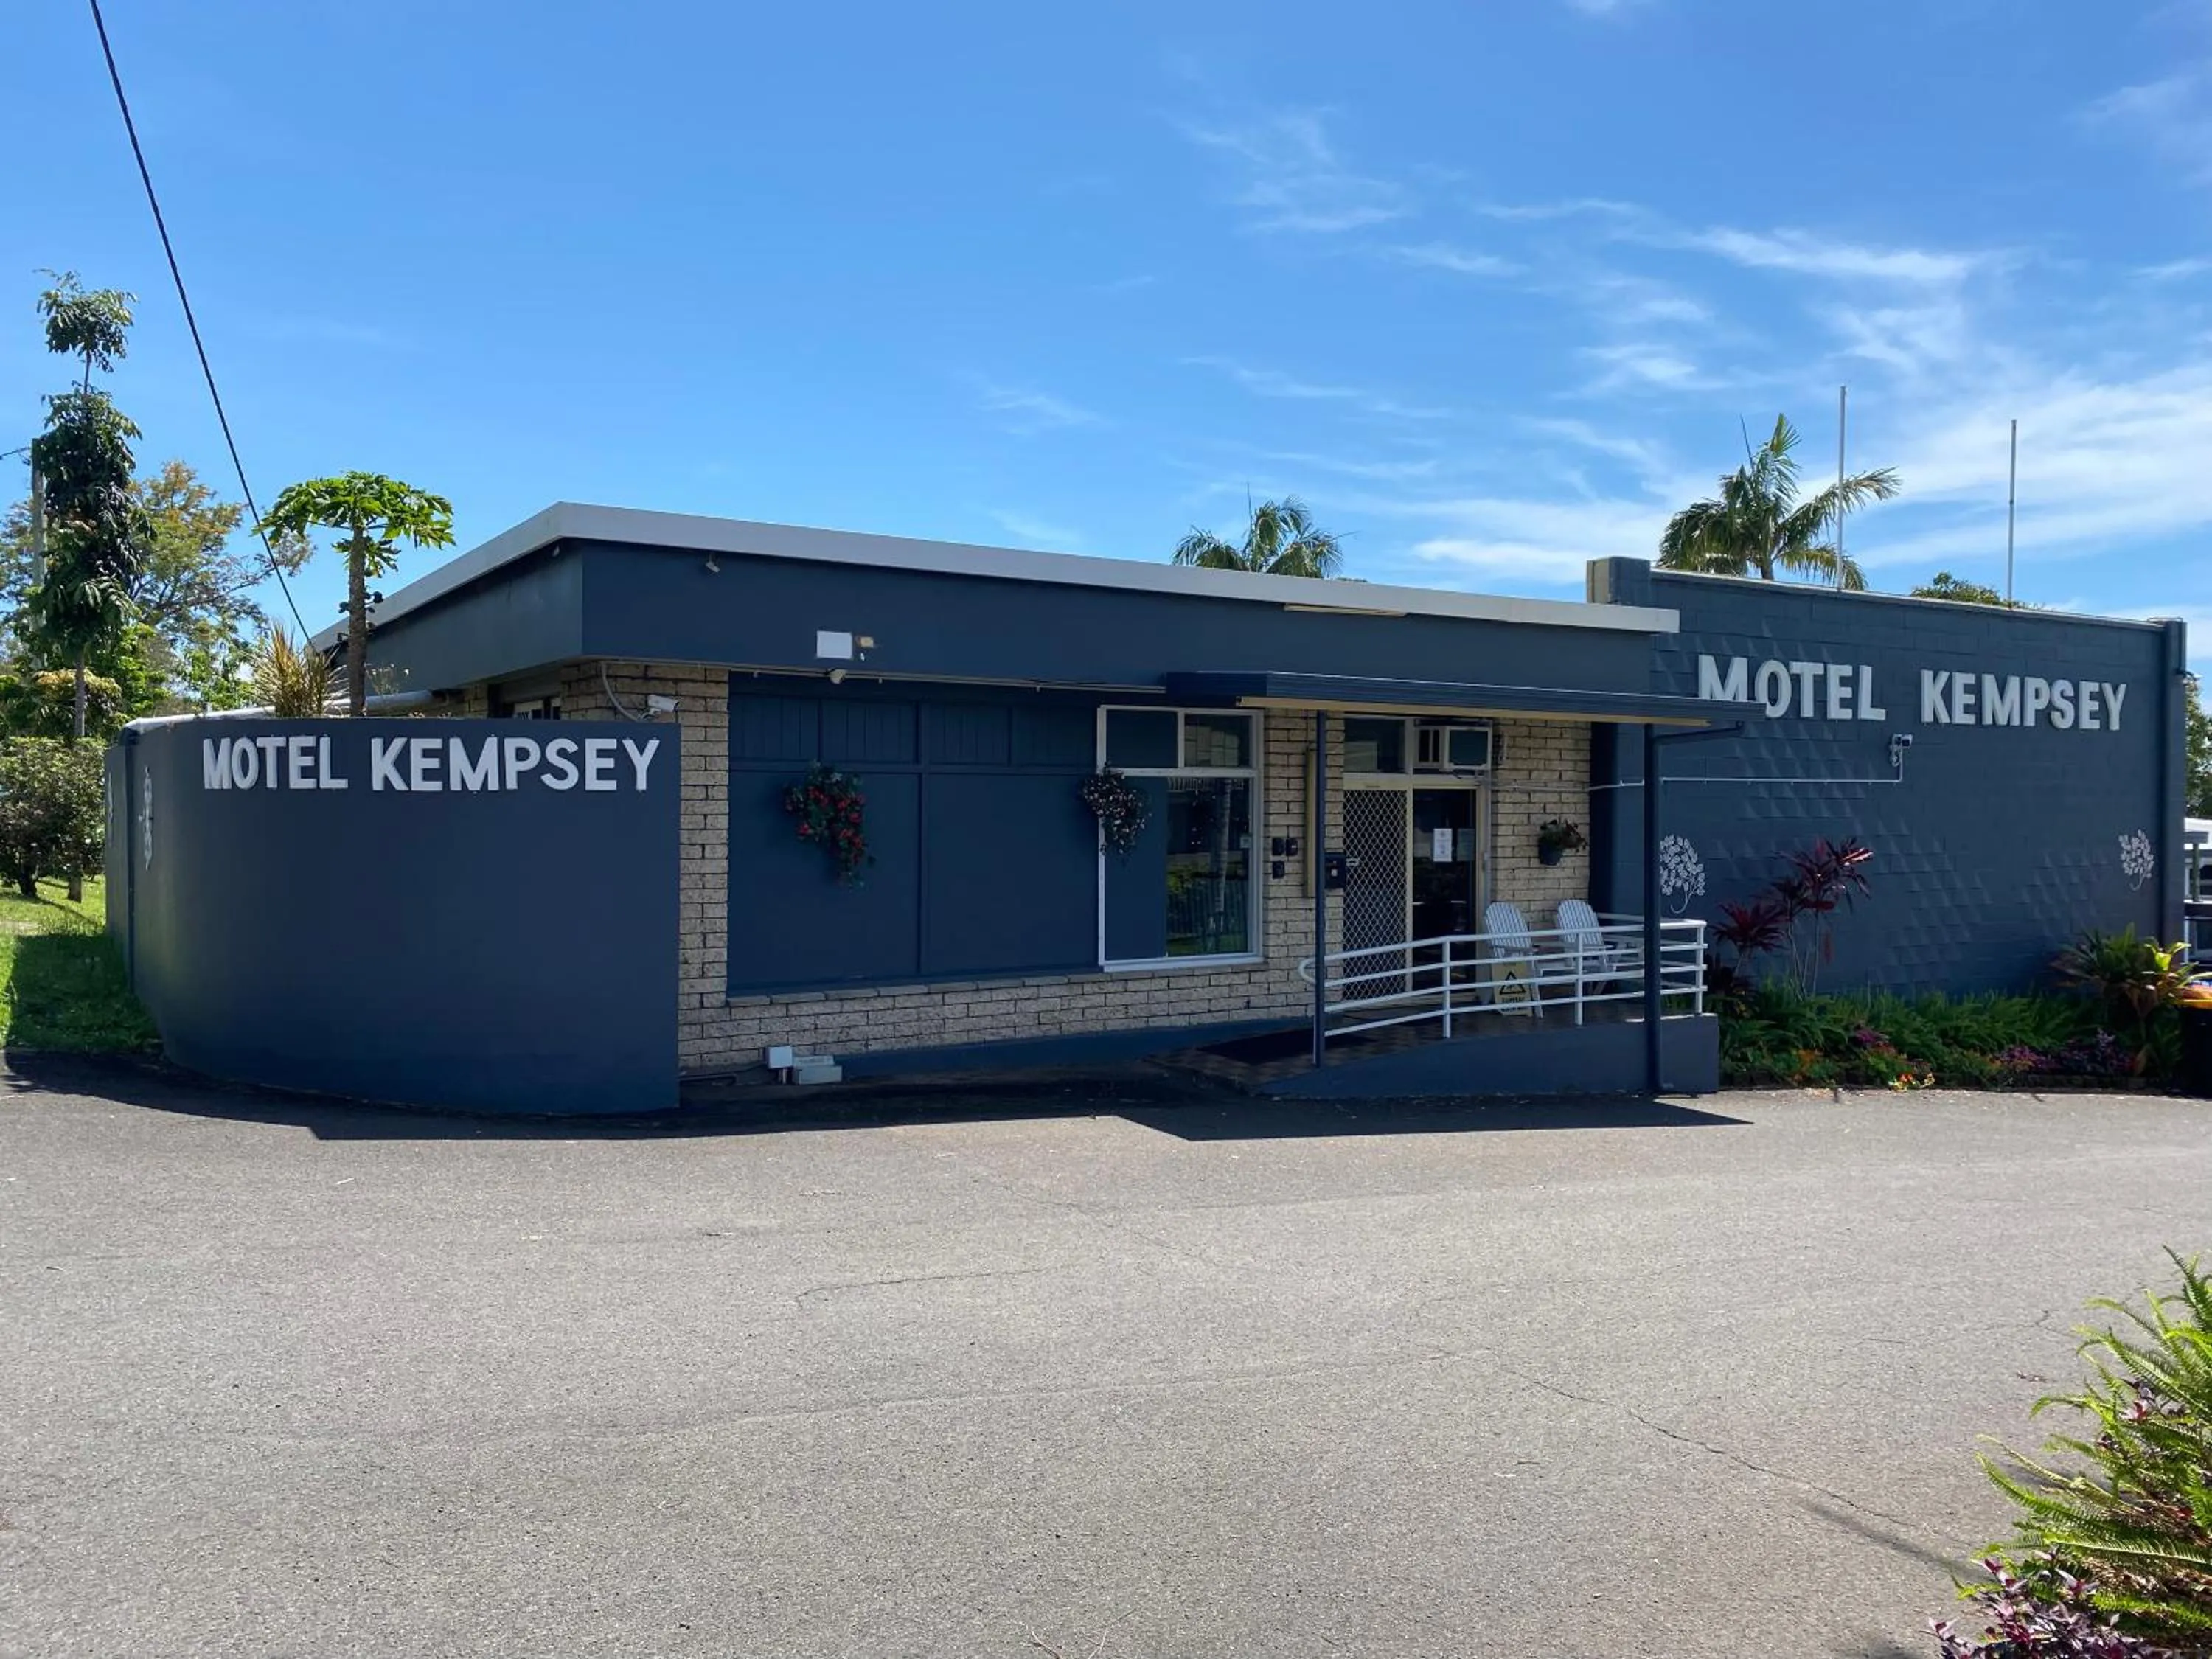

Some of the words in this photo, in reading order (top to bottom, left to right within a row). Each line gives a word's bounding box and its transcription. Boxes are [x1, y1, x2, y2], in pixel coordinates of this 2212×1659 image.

[1698, 654, 1886, 720] MOTEL
[1921, 669, 2127, 731] KEMPSEY
[203, 735, 349, 790] MOTEL
[371, 737, 660, 791] KEMPSEY
